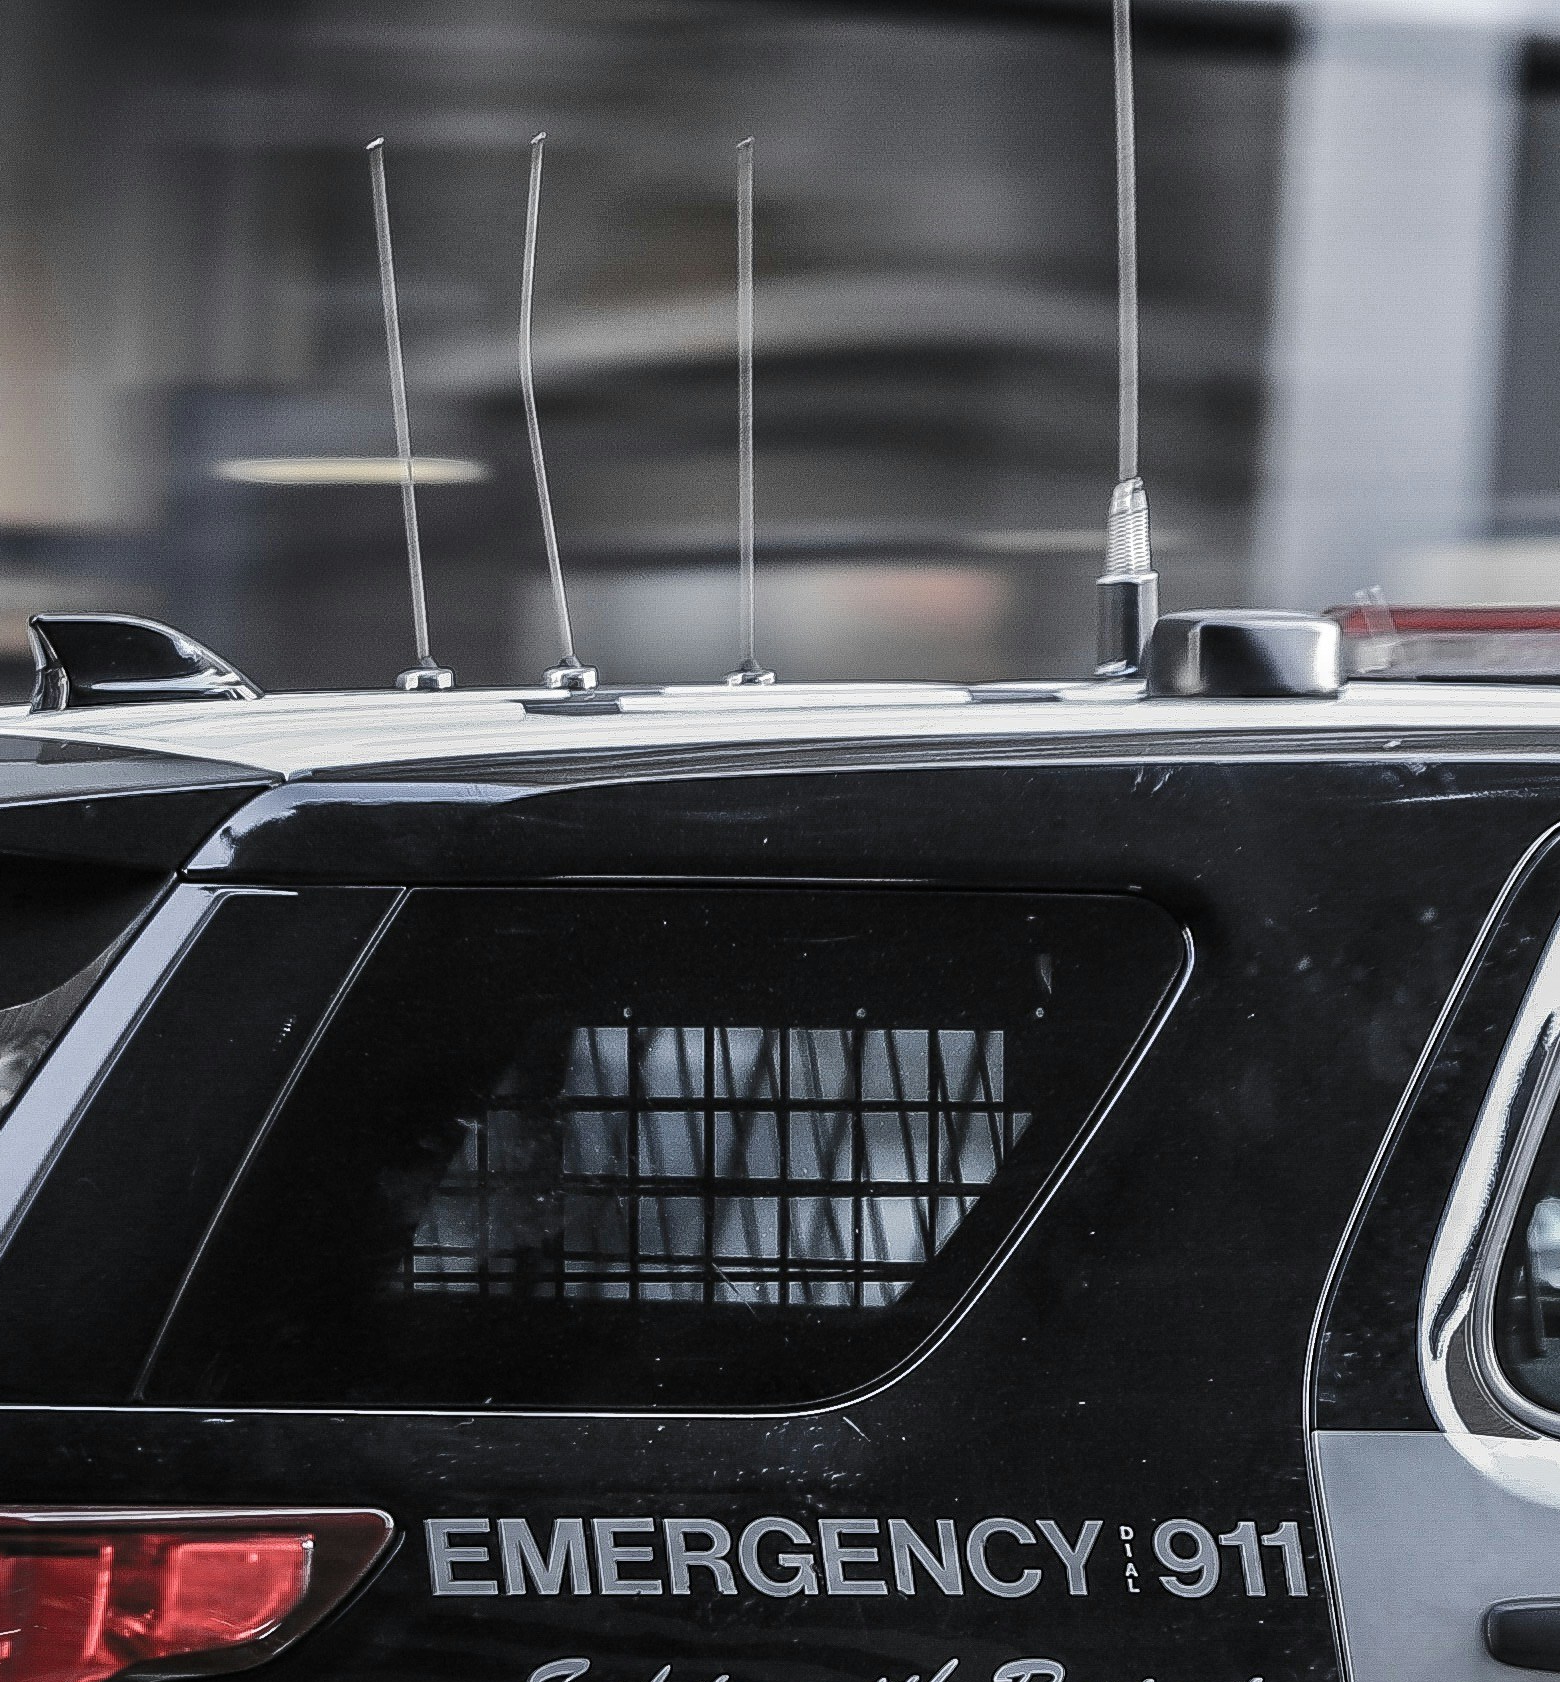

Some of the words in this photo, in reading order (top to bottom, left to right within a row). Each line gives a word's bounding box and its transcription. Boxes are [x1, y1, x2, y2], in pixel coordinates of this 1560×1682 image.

[423, 1517, 1103, 1597] EMERGENCY
[1119, 1525, 1140, 1593] DIAL
[1153, 1518, 1309, 1598] 911
